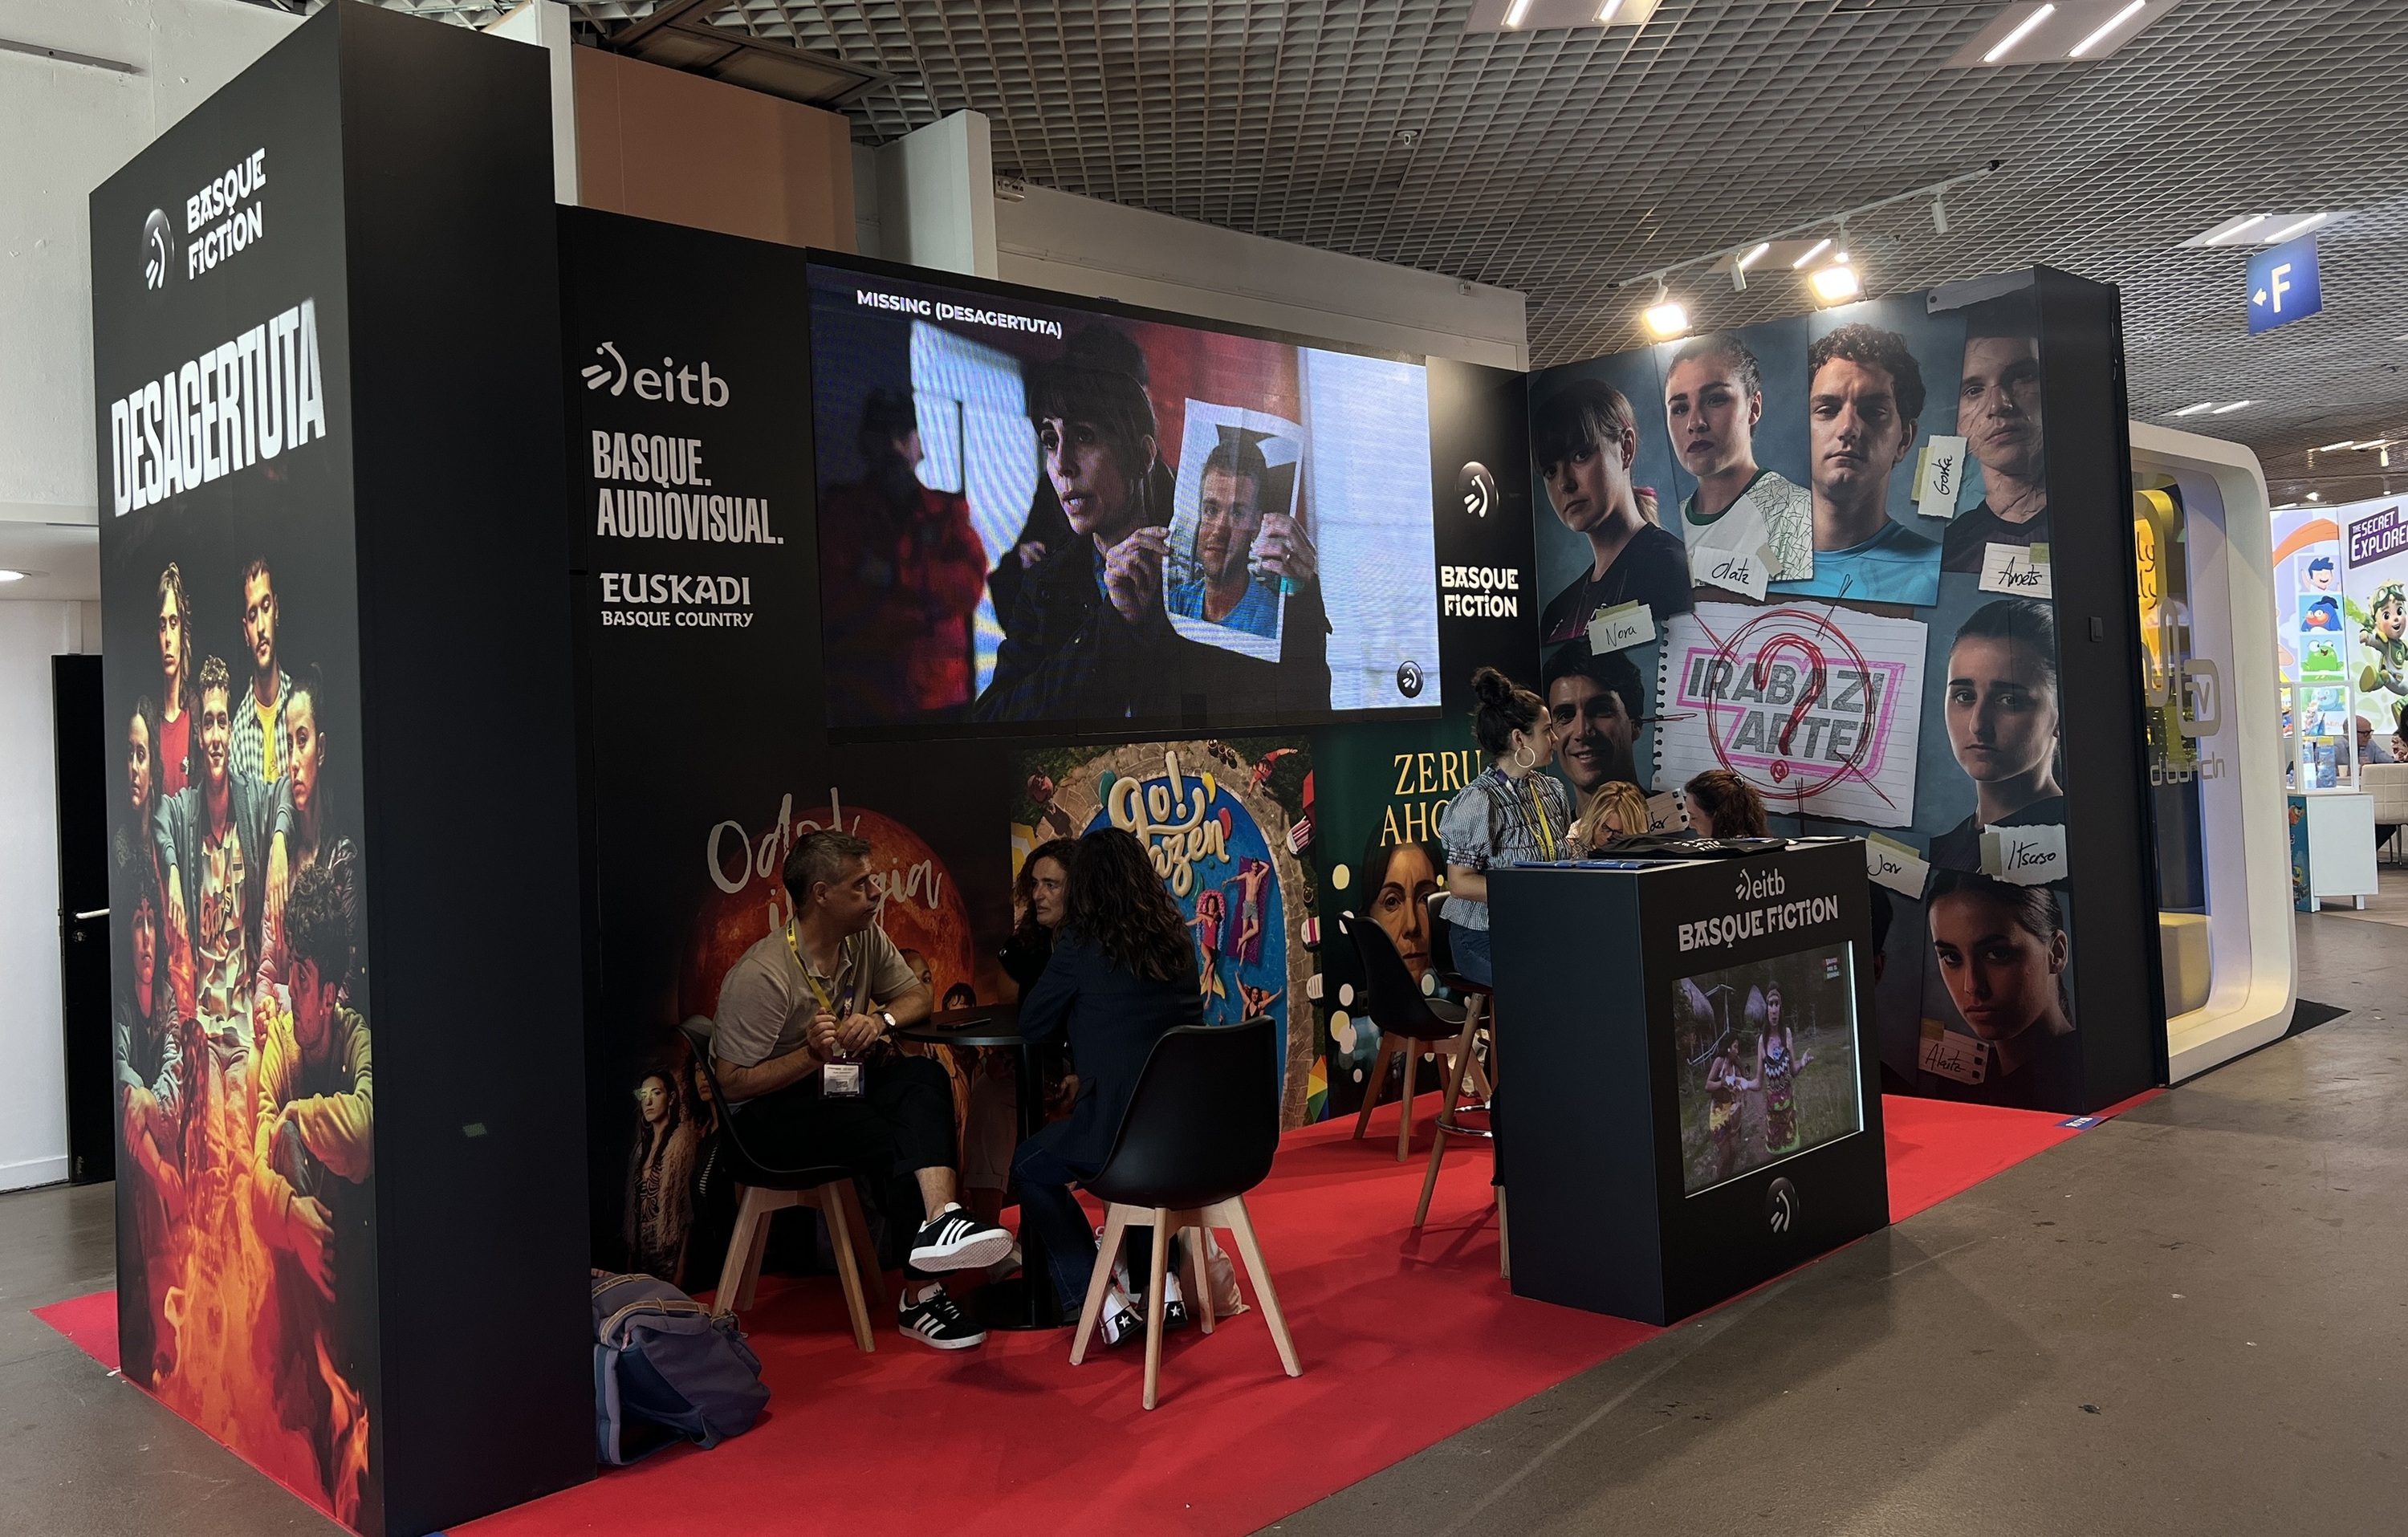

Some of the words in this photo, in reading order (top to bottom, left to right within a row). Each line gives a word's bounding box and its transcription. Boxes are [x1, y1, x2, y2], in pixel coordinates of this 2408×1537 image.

[186, 147, 267, 234] BASQUE
[2272, 262, 2291, 313] F
[856, 290, 930, 315] MISSING
[935, 302, 1063, 340] (DESAGERTUTA)
[633, 356, 730, 407] eitb
[112, 297, 326, 518] DESAGERTUTA
[592, 430, 712, 489] BASQUE.
[597, 488, 784, 544] AUDIOVISUAL.
[2352, 523, 2361, 534] THE
[2361, 510, 2396, 537] SECRET
[600, 572, 751, 606] EUSKADI
[1441, 565, 1519, 594] BASQUE
[601, 610, 671, 628] BASQUE
[674, 612, 754, 628] COUNTRY
[1605, 622, 1637, 647] Nora
[1687, 657, 1885, 714] IRABAZI
[1393, 749, 1482, 795] ZERU
[1752, 868, 1785, 899] eitb
[1678, 909, 1764, 952] BASQUE
